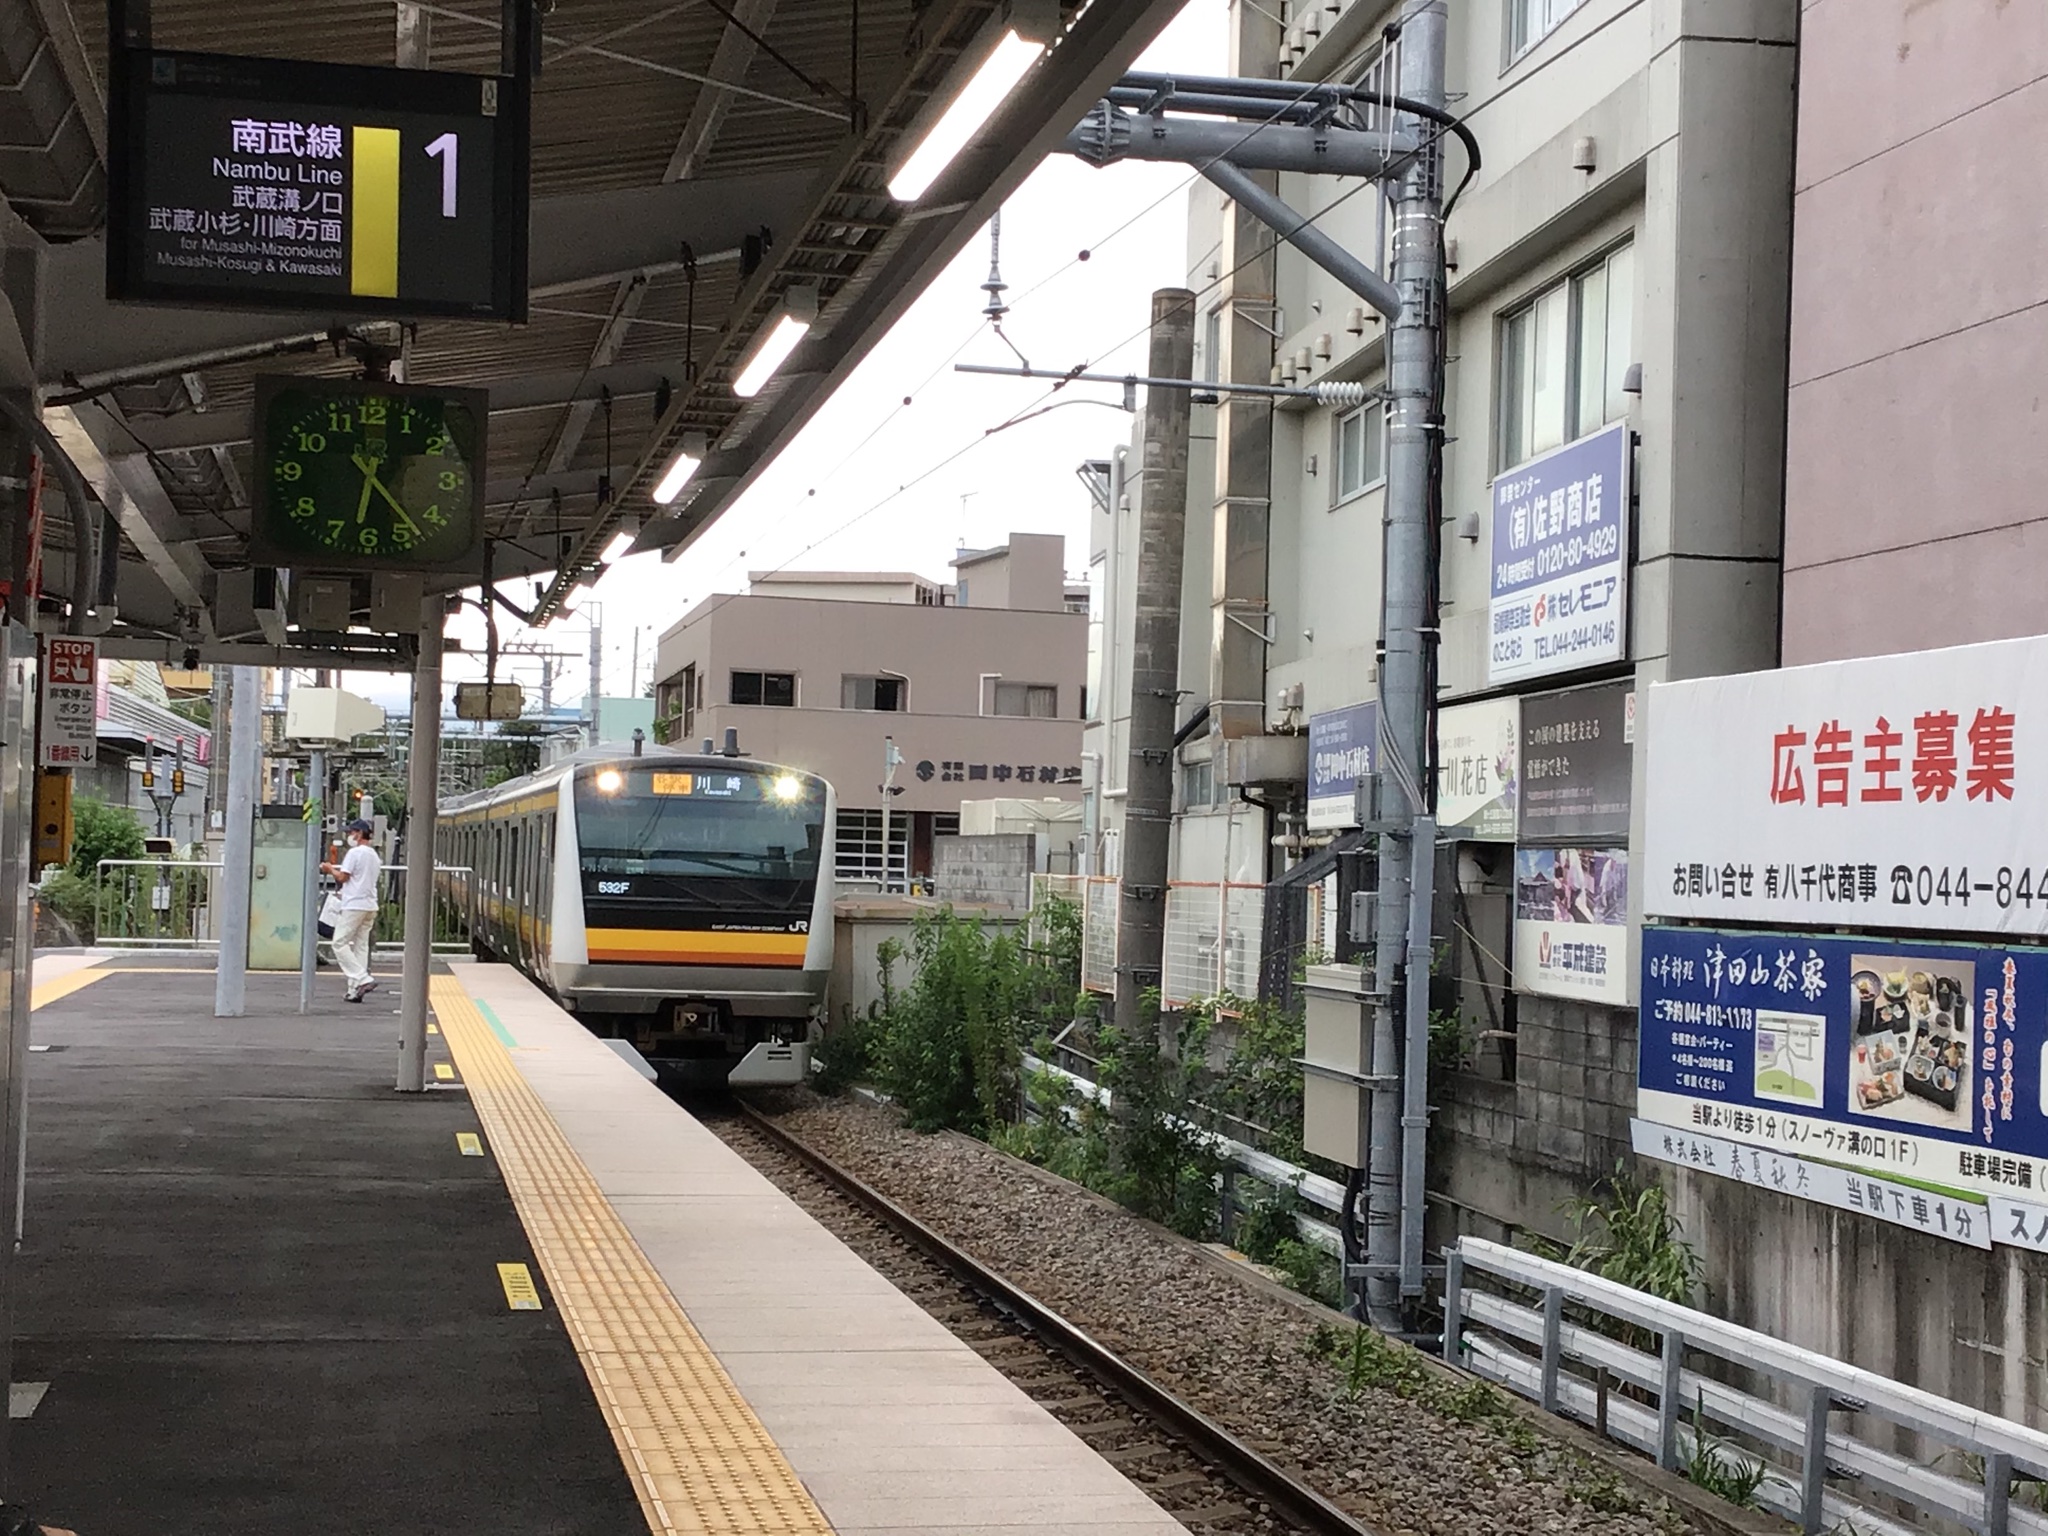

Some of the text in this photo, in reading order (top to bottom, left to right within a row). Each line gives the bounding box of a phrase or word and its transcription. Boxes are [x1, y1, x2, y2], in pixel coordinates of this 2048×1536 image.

[231, 118, 342, 160] 南武線
[213, 157, 343, 185] Nambu Line
[424, 132, 458, 218] 1
[232, 185, 342, 215] 武蔵溝ノ口
[149, 207, 342, 243] 武蔵小杉・川崎方面
[181, 236, 342, 259] for Musashi-Mizonokuchi
[157, 253, 342, 276] Musashi-Kosugi & Kawasaki
[328, 413, 353, 433] 11
[358, 406, 387, 425] 12
[401, 415, 412, 434] 1
[298, 433, 326, 452] 10
[426, 438, 444, 456] 2
[283, 462, 302, 481] 9
[438, 471, 457, 490] 3
[297, 497, 316, 517] 8
[422, 505, 441, 523] 4
[327, 520, 345, 539] 7
[359, 528, 379, 547] 6
[392, 524, 411, 542] 5
[1537, 524, 1617, 577] 0120-80-4929
[53, 642, 92, 655] STOP
[50, 687, 92, 701] 非常停止
[60, 703, 92, 715] ボタン
[1770, 705, 2016, 808] 広告主募集
[1673, 862, 1754, 899] お問い合せ
[788, 920, 808, 933] JR
[1650, 953, 1694, 988] 日本料理
[1655, 999, 1683, 1023] ご予約
[1664, 1134, 1972, 1239] 株式会社 春夏秋冬 当駅下車1分
